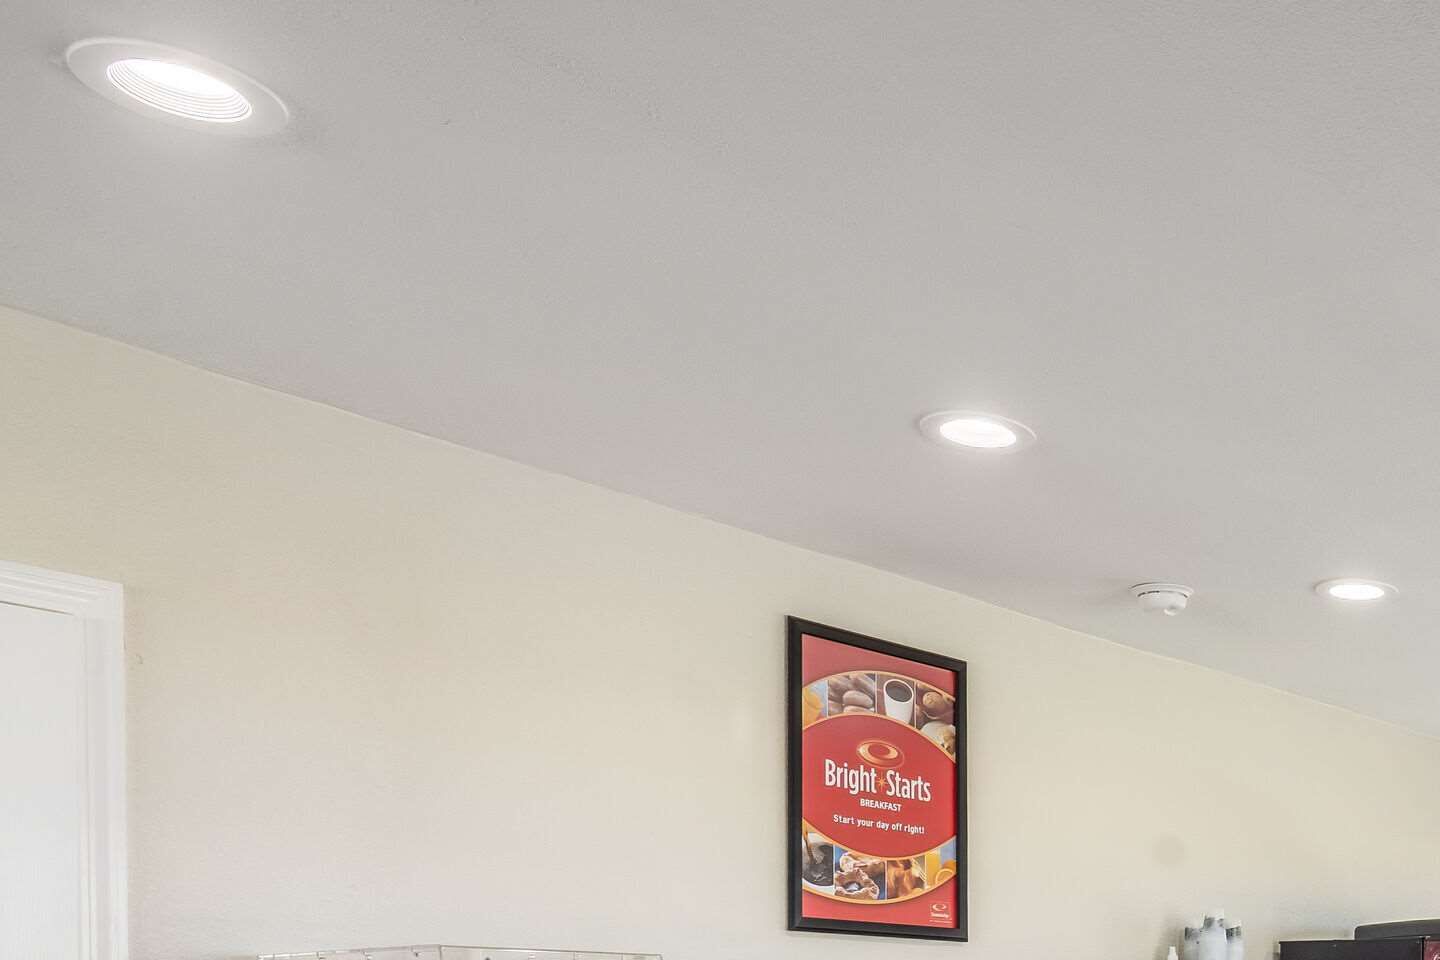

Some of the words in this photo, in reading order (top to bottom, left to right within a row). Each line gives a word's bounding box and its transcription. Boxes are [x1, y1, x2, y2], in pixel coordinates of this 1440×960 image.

[824, 758, 878, 795] Bright
[885, 769, 932, 802] Starts
[860, 798, 902, 812] BREAKFAST
[833, 814, 855, 825] Start
[857, 817, 875, 828] your
[876, 820, 890, 831] day
[891, 822, 903, 832] off
[904, 824, 925, 835] right!
